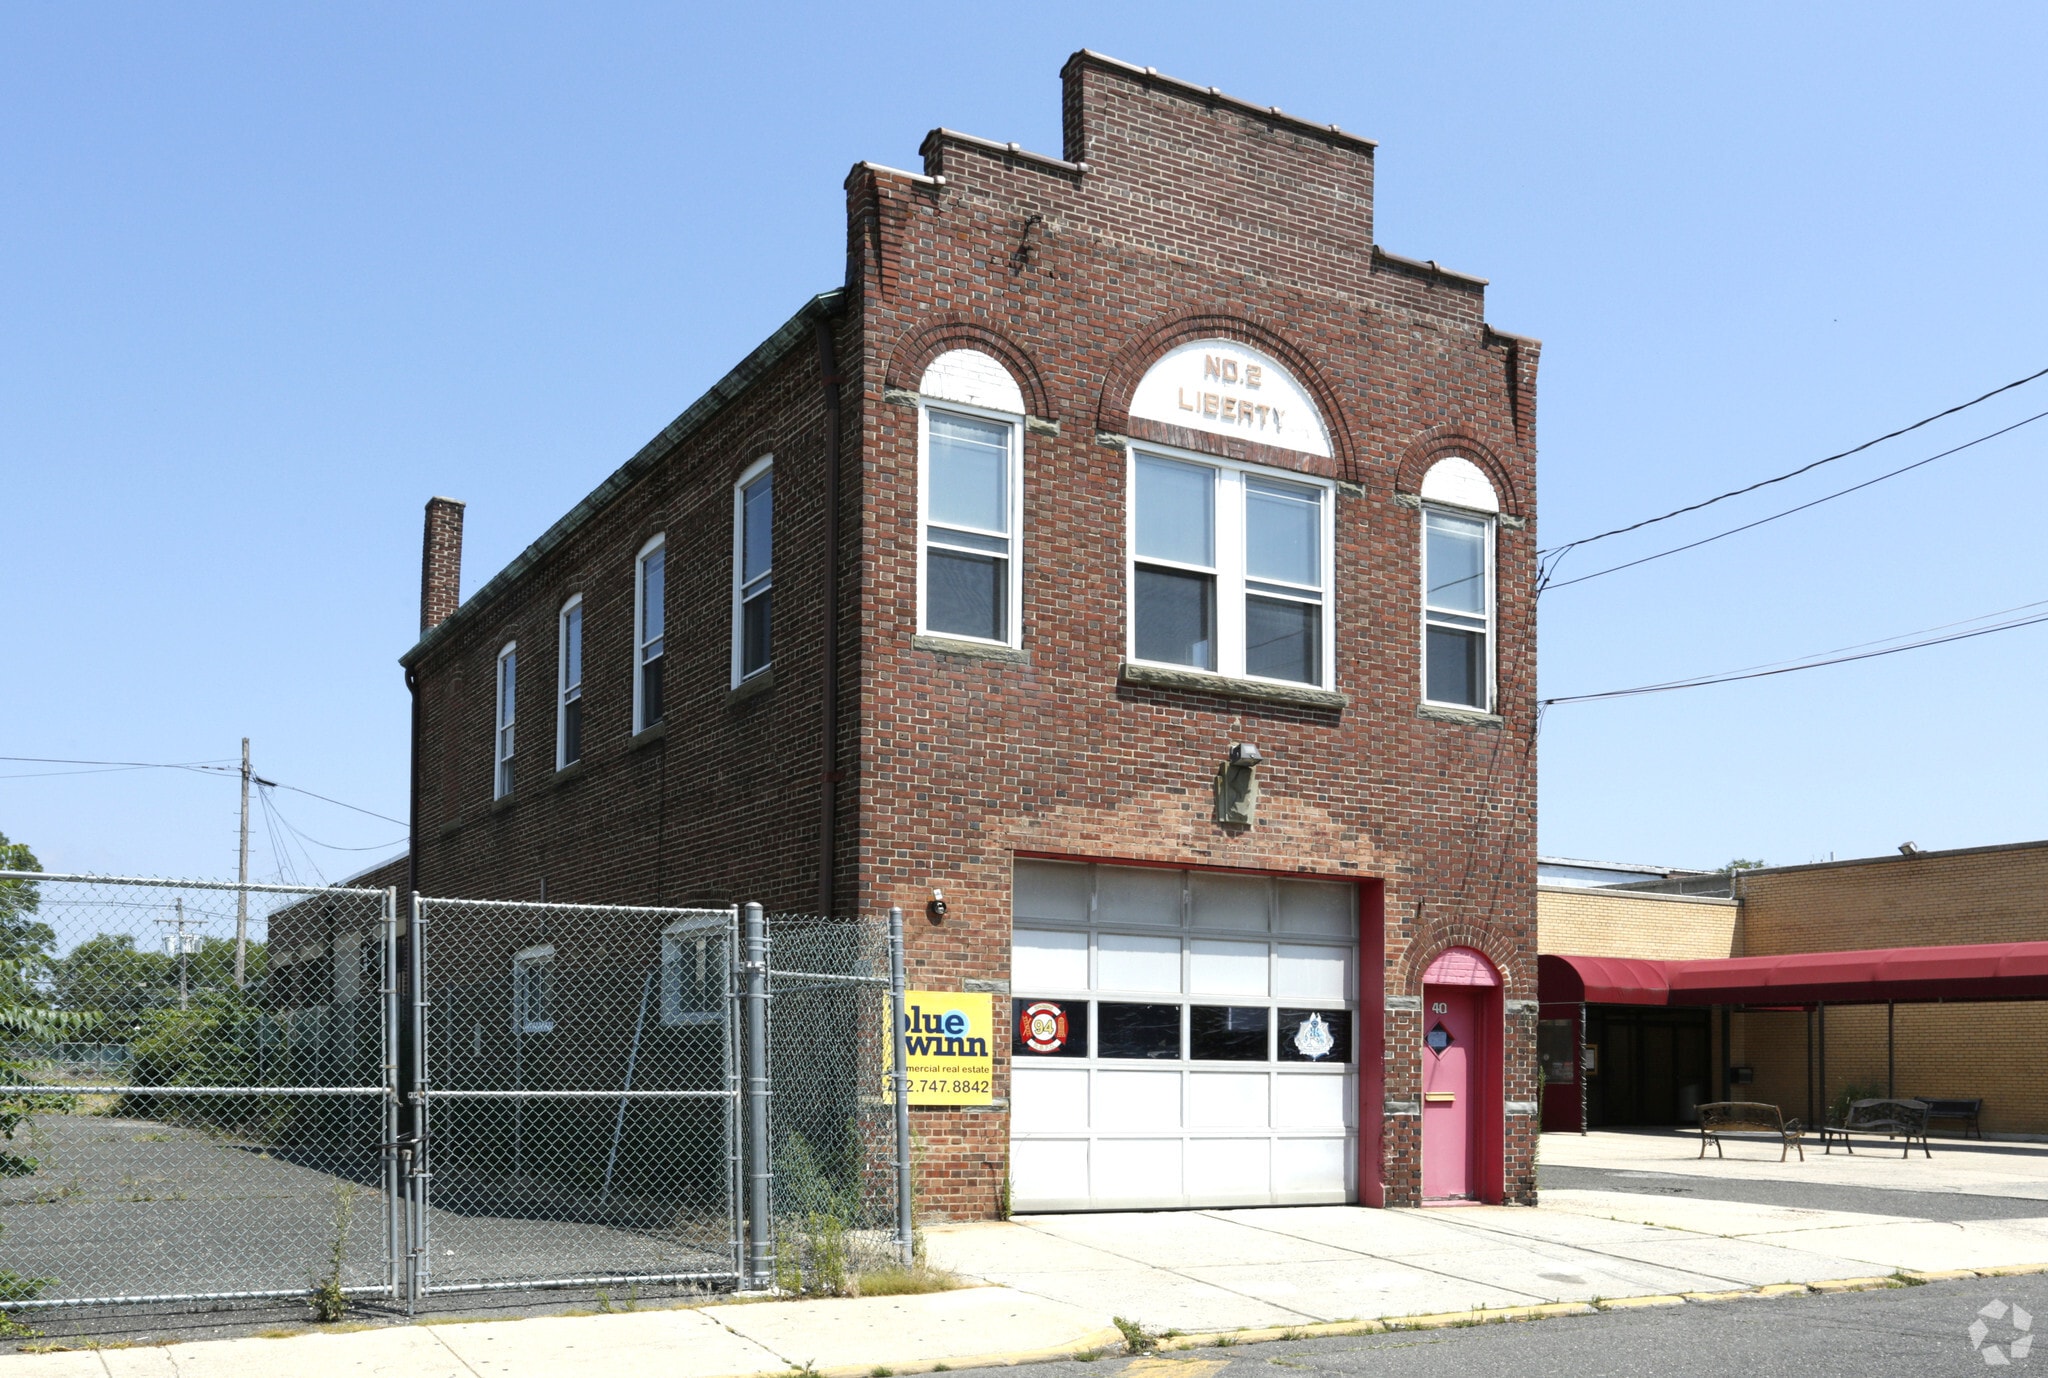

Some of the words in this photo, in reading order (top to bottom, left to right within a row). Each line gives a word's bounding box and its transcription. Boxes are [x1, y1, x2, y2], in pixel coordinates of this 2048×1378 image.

[1178, 387, 1286, 434] LIBERTY
[1431, 1002, 1448, 1014] 40
[1034, 1019, 1054, 1035] 94
[905, 1036, 989, 1057] winn
[942, 1065, 960, 1073] real
[962, 1066, 990, 1074] estate
